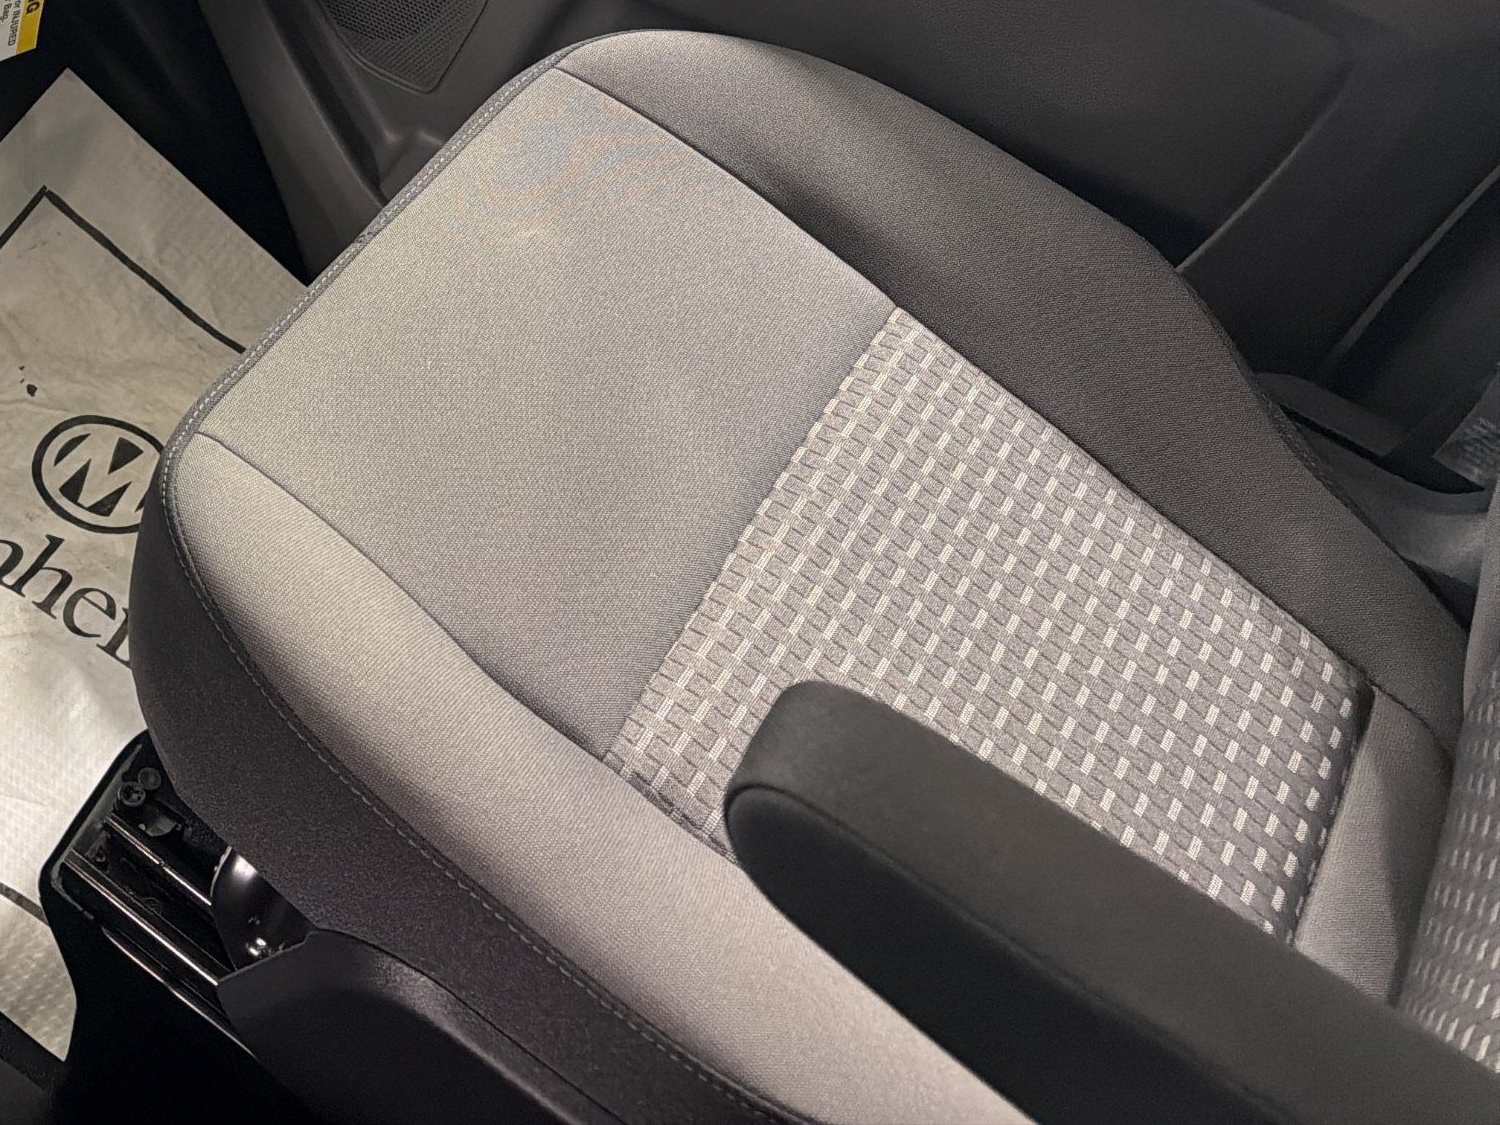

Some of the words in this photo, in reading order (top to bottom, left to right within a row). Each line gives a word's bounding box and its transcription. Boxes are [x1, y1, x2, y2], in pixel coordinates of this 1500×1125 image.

[0, 2, 12, 23] Bag.
[13, 0, 21, 9] or
[7, 8, 21, 47] INJURED
